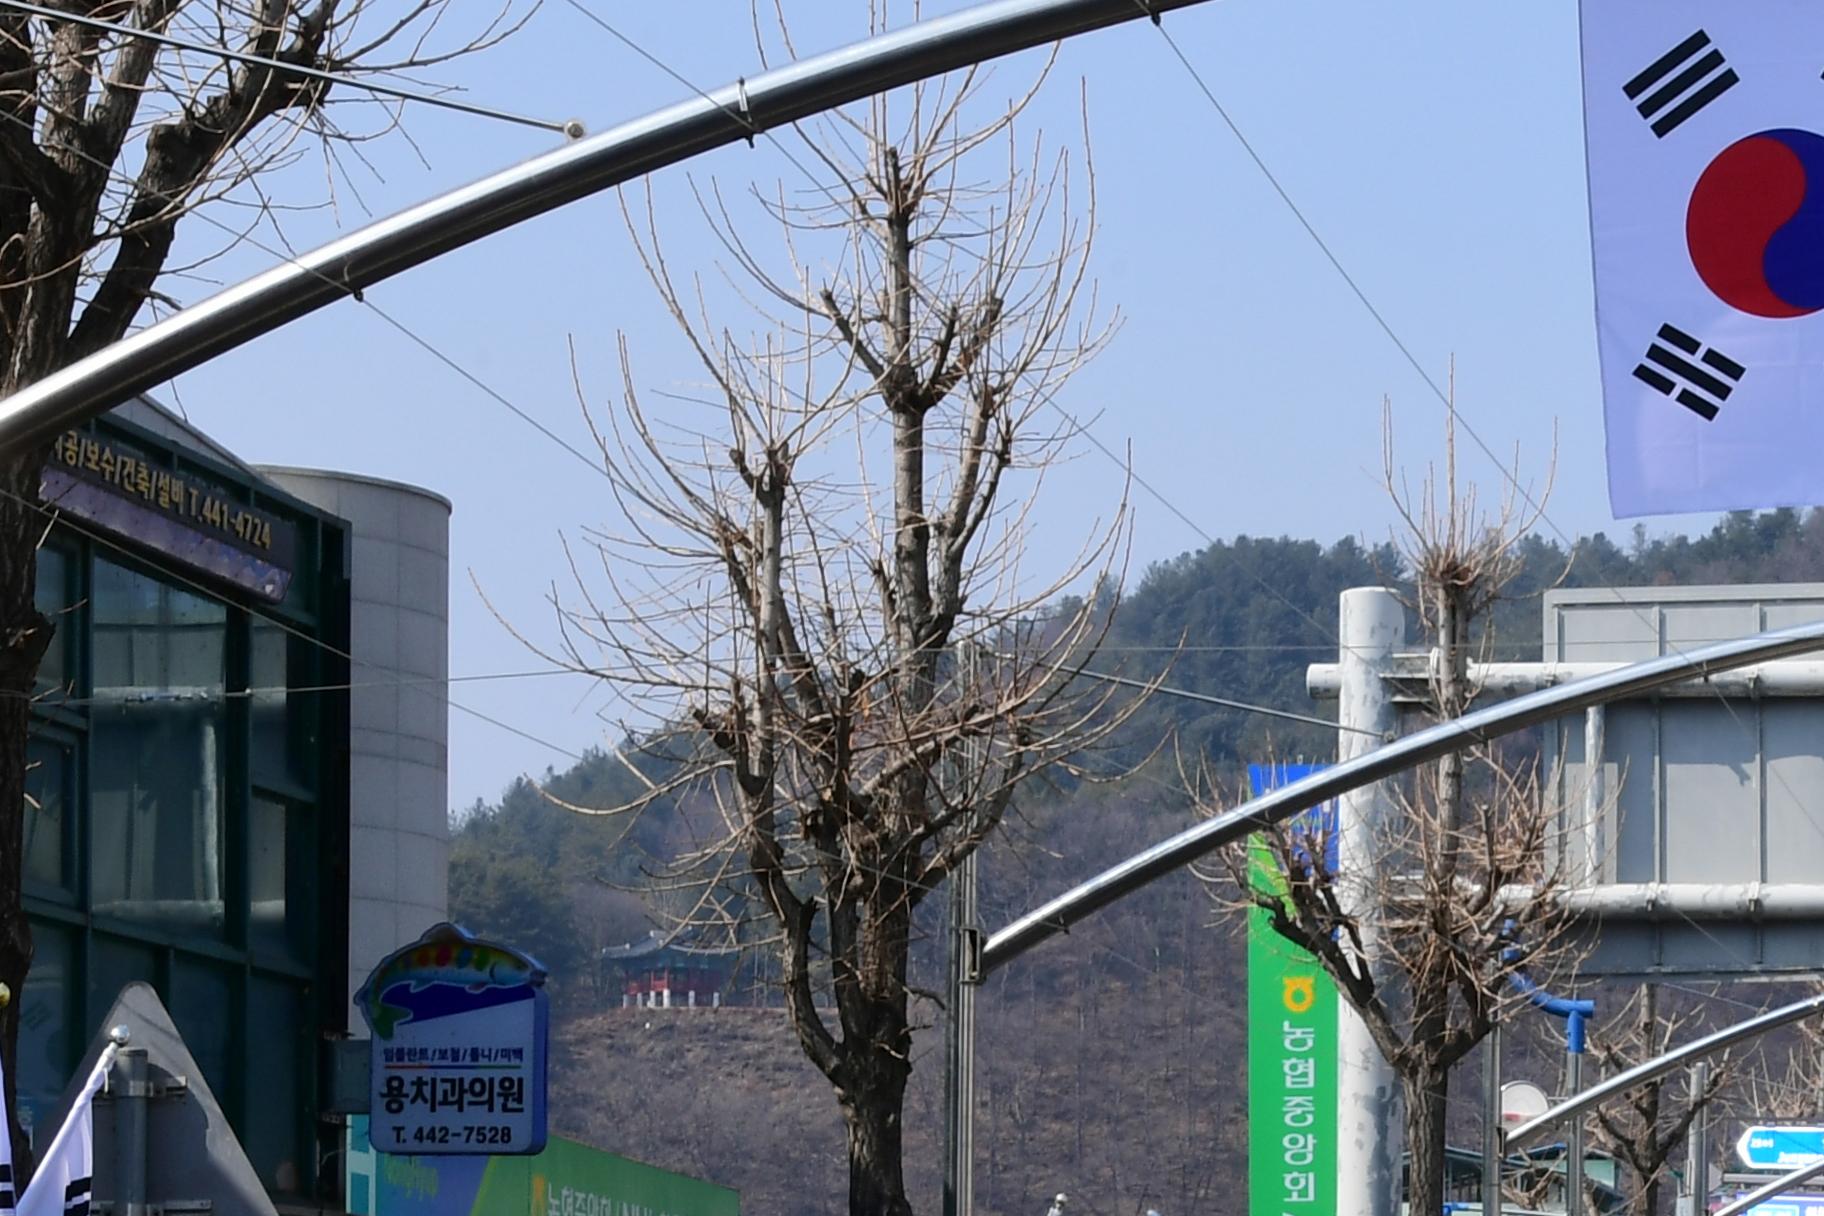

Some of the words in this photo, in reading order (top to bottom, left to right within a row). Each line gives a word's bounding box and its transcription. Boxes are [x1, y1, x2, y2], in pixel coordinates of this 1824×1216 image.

[188, 483, 272, 550] T.441-4724
[379, 1075, 525, 1115] 용치과의원
[391, 1126, 407, 1144] T.
[413, 1126, 512, 1144] 442-7528
